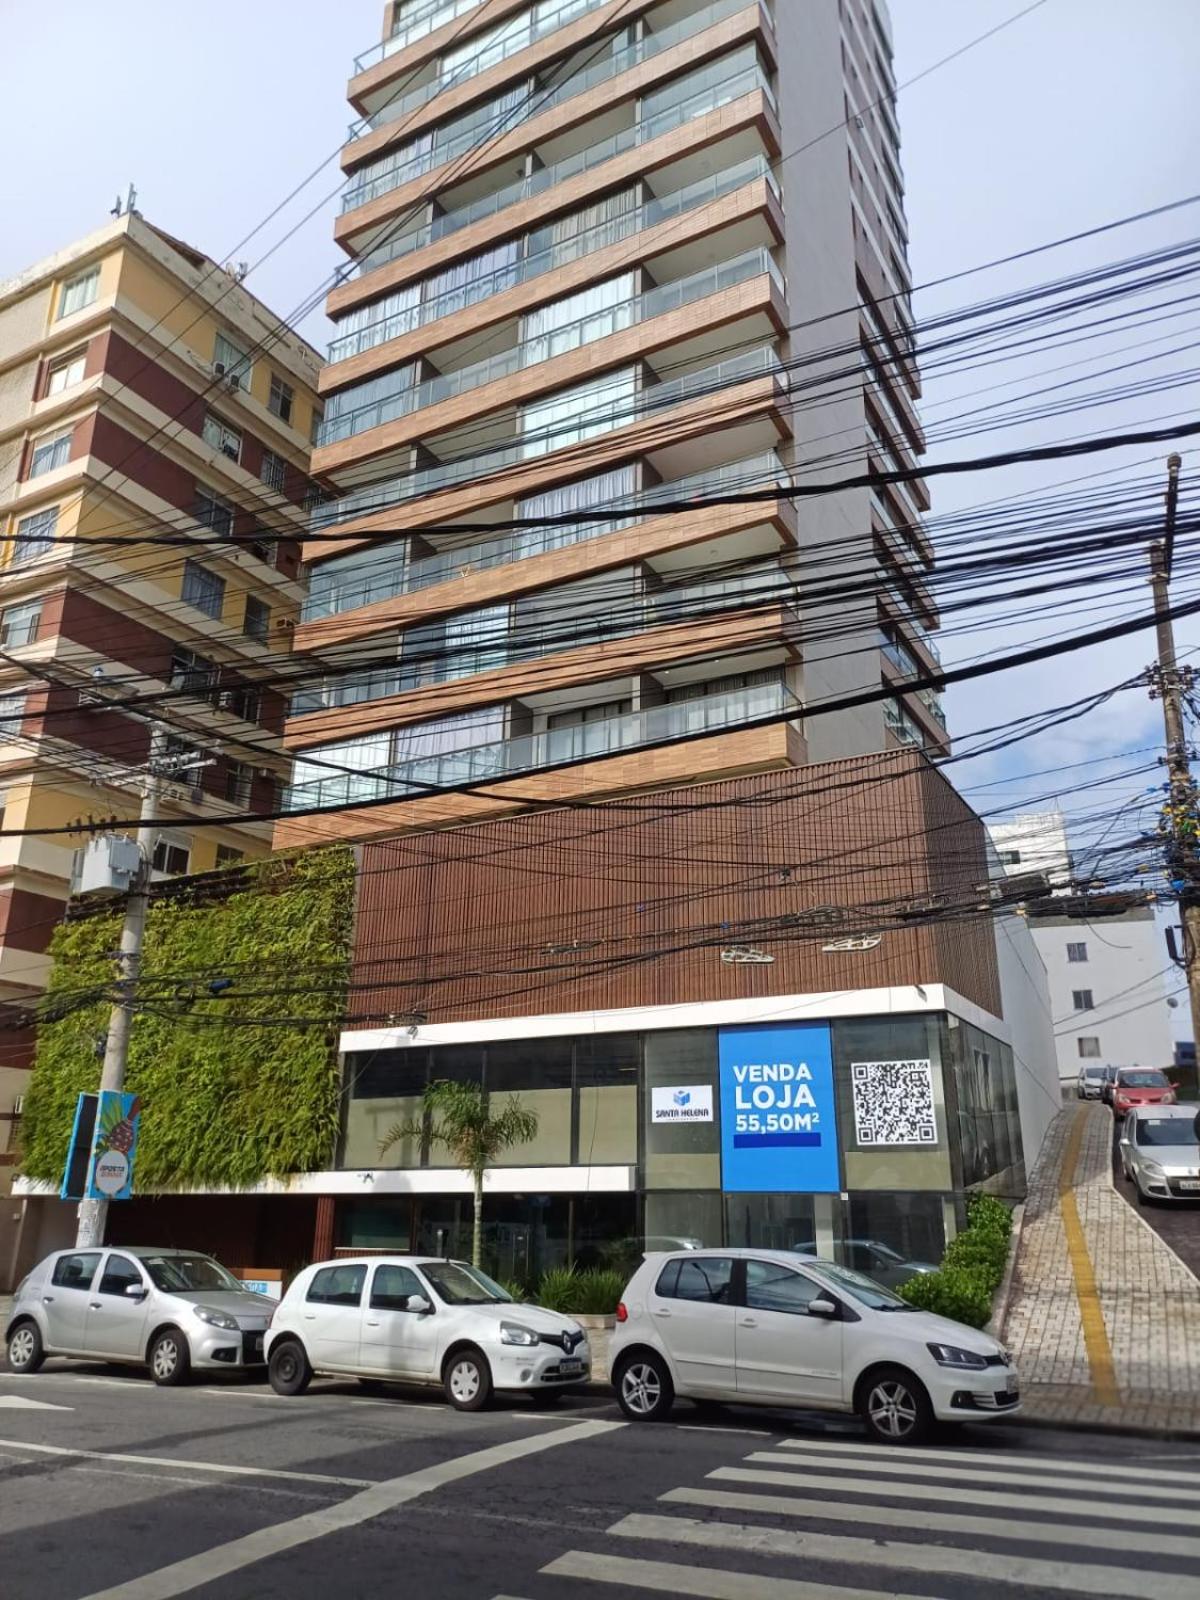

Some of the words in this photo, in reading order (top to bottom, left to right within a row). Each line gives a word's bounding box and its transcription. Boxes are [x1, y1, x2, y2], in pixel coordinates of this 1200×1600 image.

[733, 1063, 812, 1083] VENDA
[735, 1084, 816, 1110] LOJA
[656, 1109, 679, 1118] SANTA
[681, 1108, 709, 1118] HELENA
